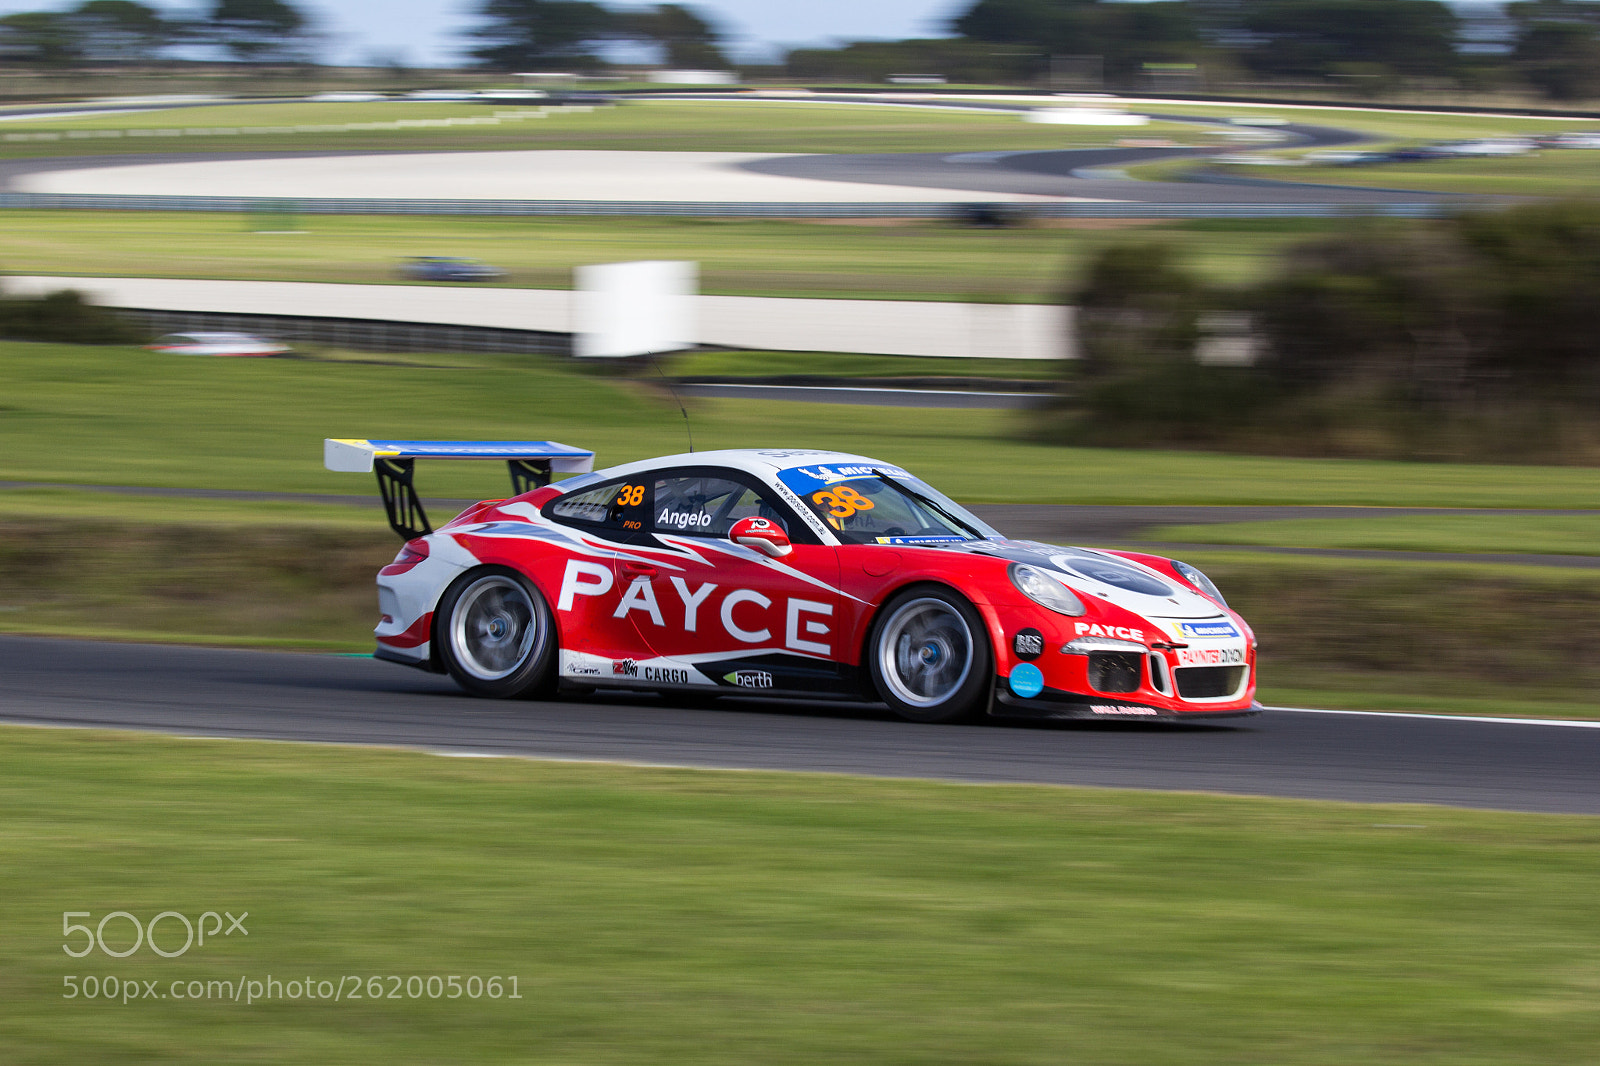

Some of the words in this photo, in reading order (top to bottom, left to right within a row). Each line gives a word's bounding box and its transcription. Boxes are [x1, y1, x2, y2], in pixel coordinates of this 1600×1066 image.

[616, 484, 646, 507] 38
[812, 485, 875, 518] 38
[657, 507, 712, 529] Angelo
[774, 481, 827, 536] www.porsche.com.au
[622, 520, 642, 530] PRO
[557, 558, 834, 656] PAYCE
[1074, 622, 1145, 642] PAYCE
[644, 667, 689, 684] CARGO
[734, 671, 774, 688] berth
